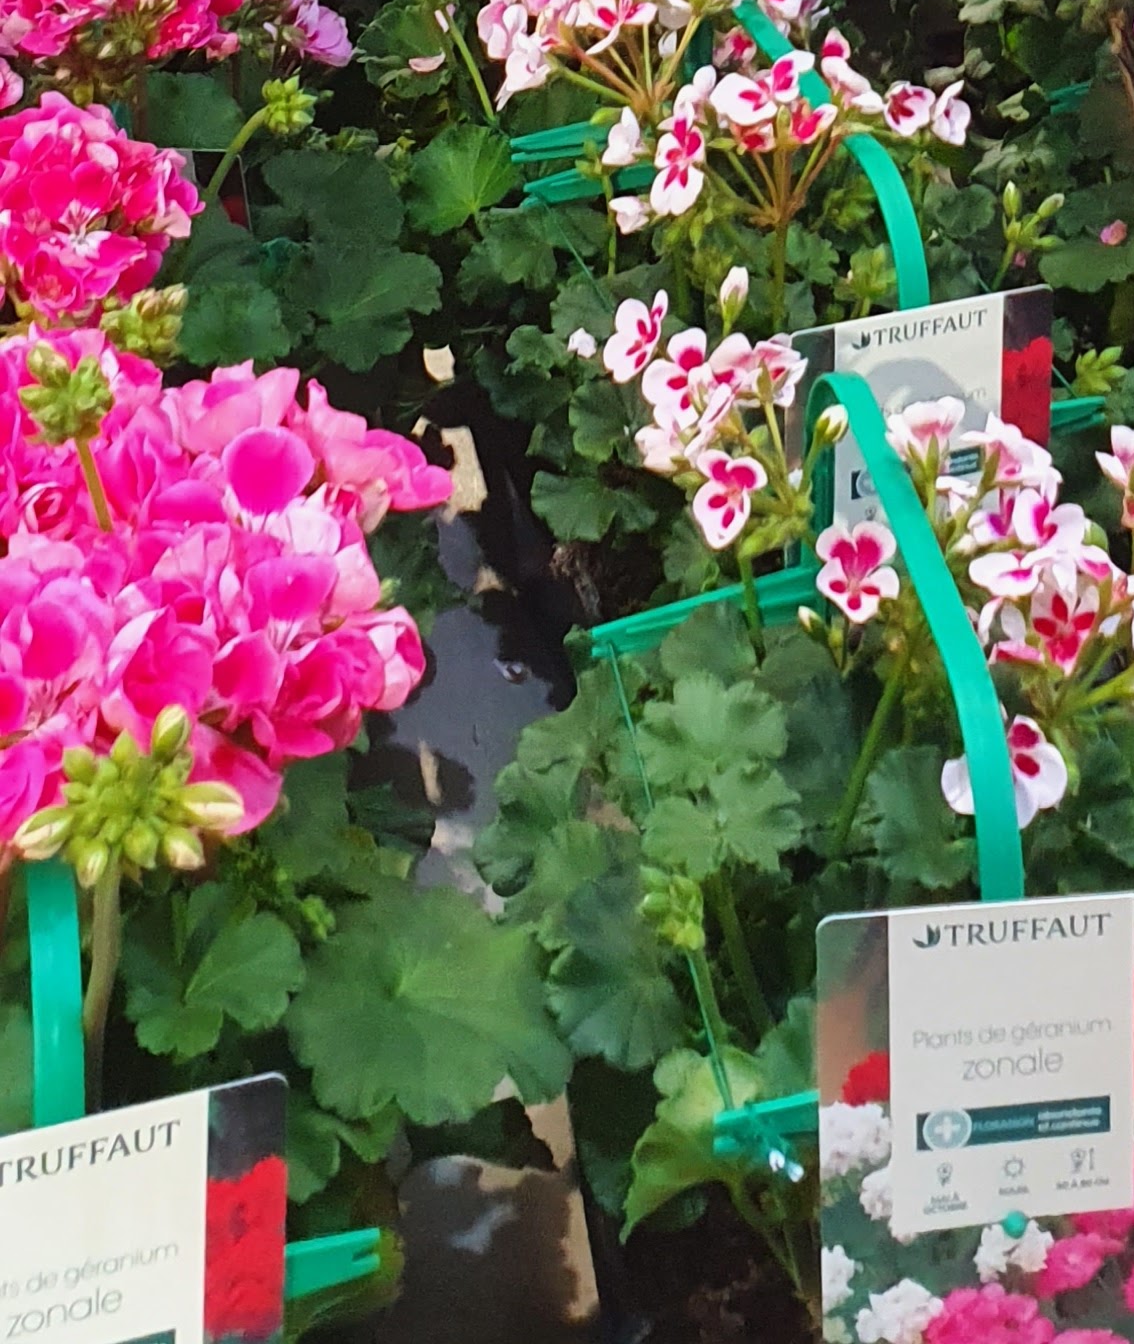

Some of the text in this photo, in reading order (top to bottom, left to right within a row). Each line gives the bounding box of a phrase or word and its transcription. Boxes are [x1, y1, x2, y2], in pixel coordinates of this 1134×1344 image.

[873, 308, 988, 346] TRUFFAUT
[944, 913, 1112, 948] TRUFFAUT
[912, 1016, 1113, 1050] Plants de géranium
[961, 1045, 1065, 1082] zonale
[0, 1119, 181, 1186] TRUFFAUT
[26, 1270, 58, 1295] de
[64, 1242, 179, 1290] géranium
[6, 1287, 123, 1339] zonale
